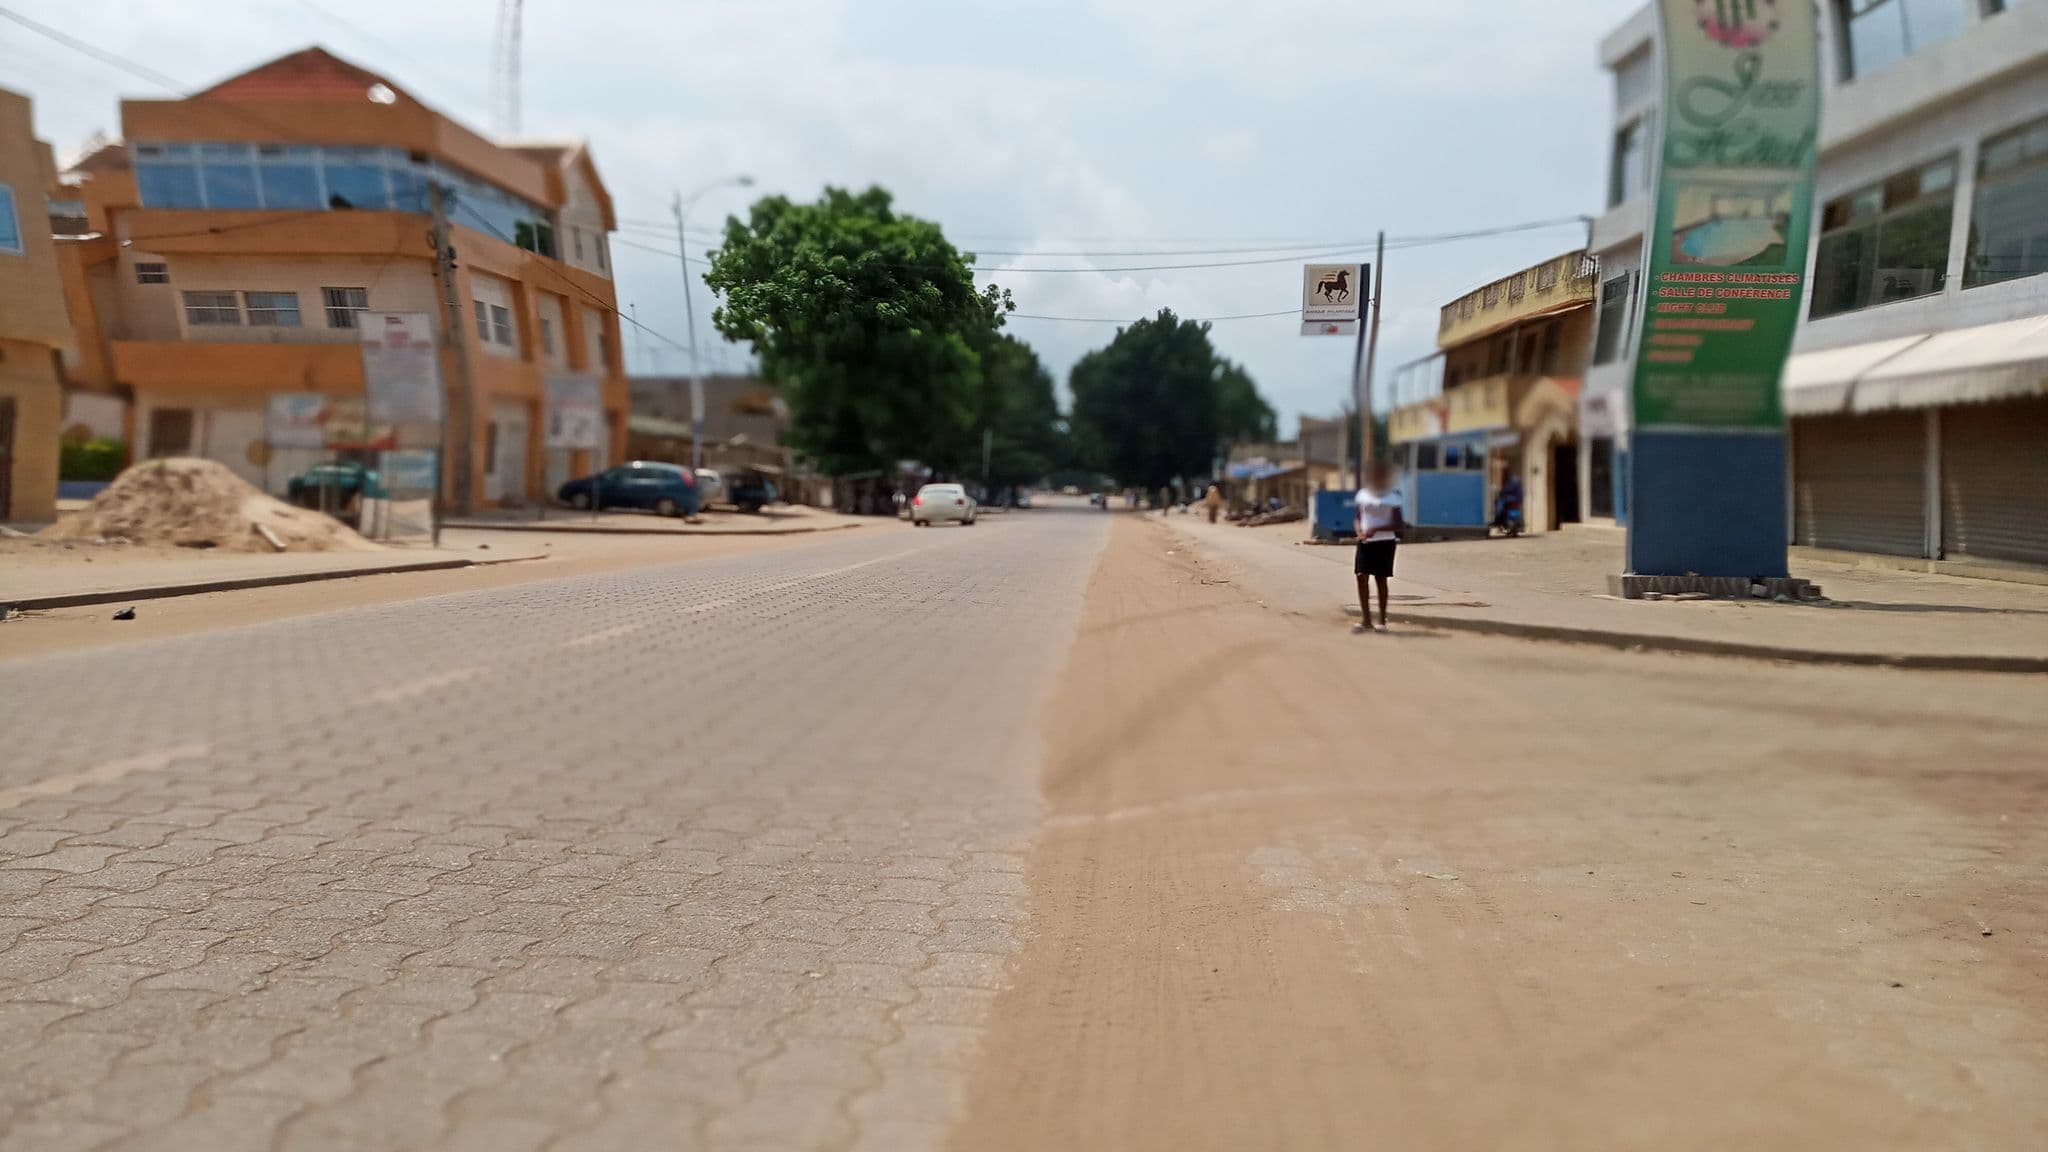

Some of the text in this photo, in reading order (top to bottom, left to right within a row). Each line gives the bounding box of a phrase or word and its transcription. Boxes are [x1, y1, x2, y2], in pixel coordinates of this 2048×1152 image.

[1661, 273, 1724, 282] CHAMBRES
[1659, 288, 1695, 297] SALLE
[1698, 288, 1713, 297] DE
[1657, 303, 1726, 313] NIGHT CLUB
